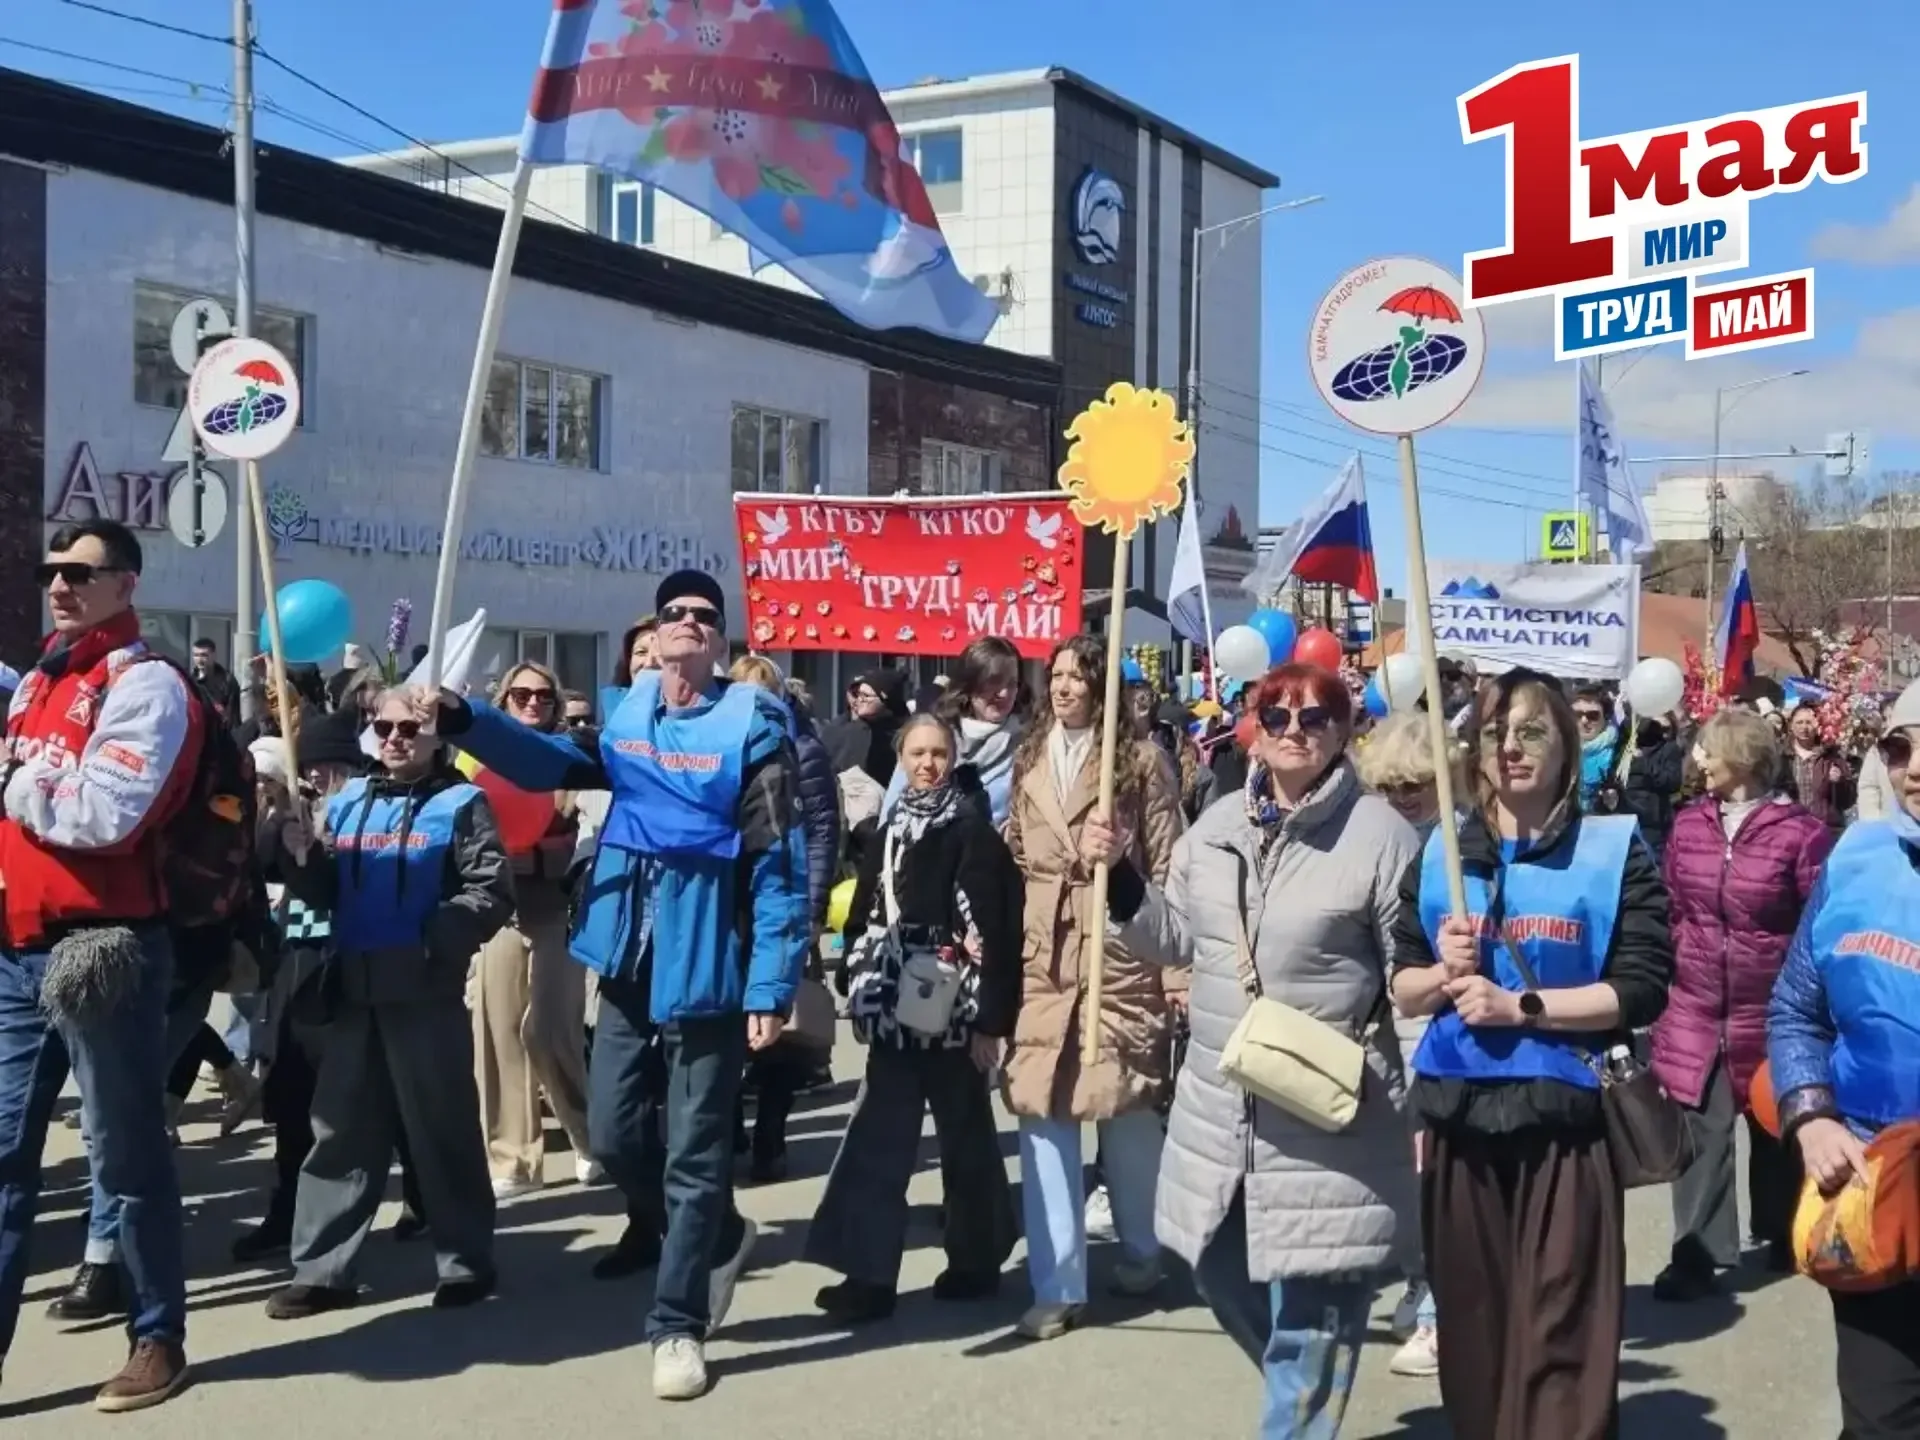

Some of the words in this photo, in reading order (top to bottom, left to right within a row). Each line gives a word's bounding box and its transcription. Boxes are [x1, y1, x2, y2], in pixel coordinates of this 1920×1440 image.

[1315, 265, 1388, 363] КАМЧАТГИДРОМЕТ
[799, 505, 887, 535] КГБУ
[325, 517, 507, 560] МЕДИЦИНКИЙ
[507, 535, 581, 569] ЦЕНТР
[758, 547, 850, 582] МИР!
[863, 574, 961, 618] ТРУД!
[966, 593, 1061, 640] МАЙ!
[1429, 603, 1625, 628] СТАТИСТИКА
